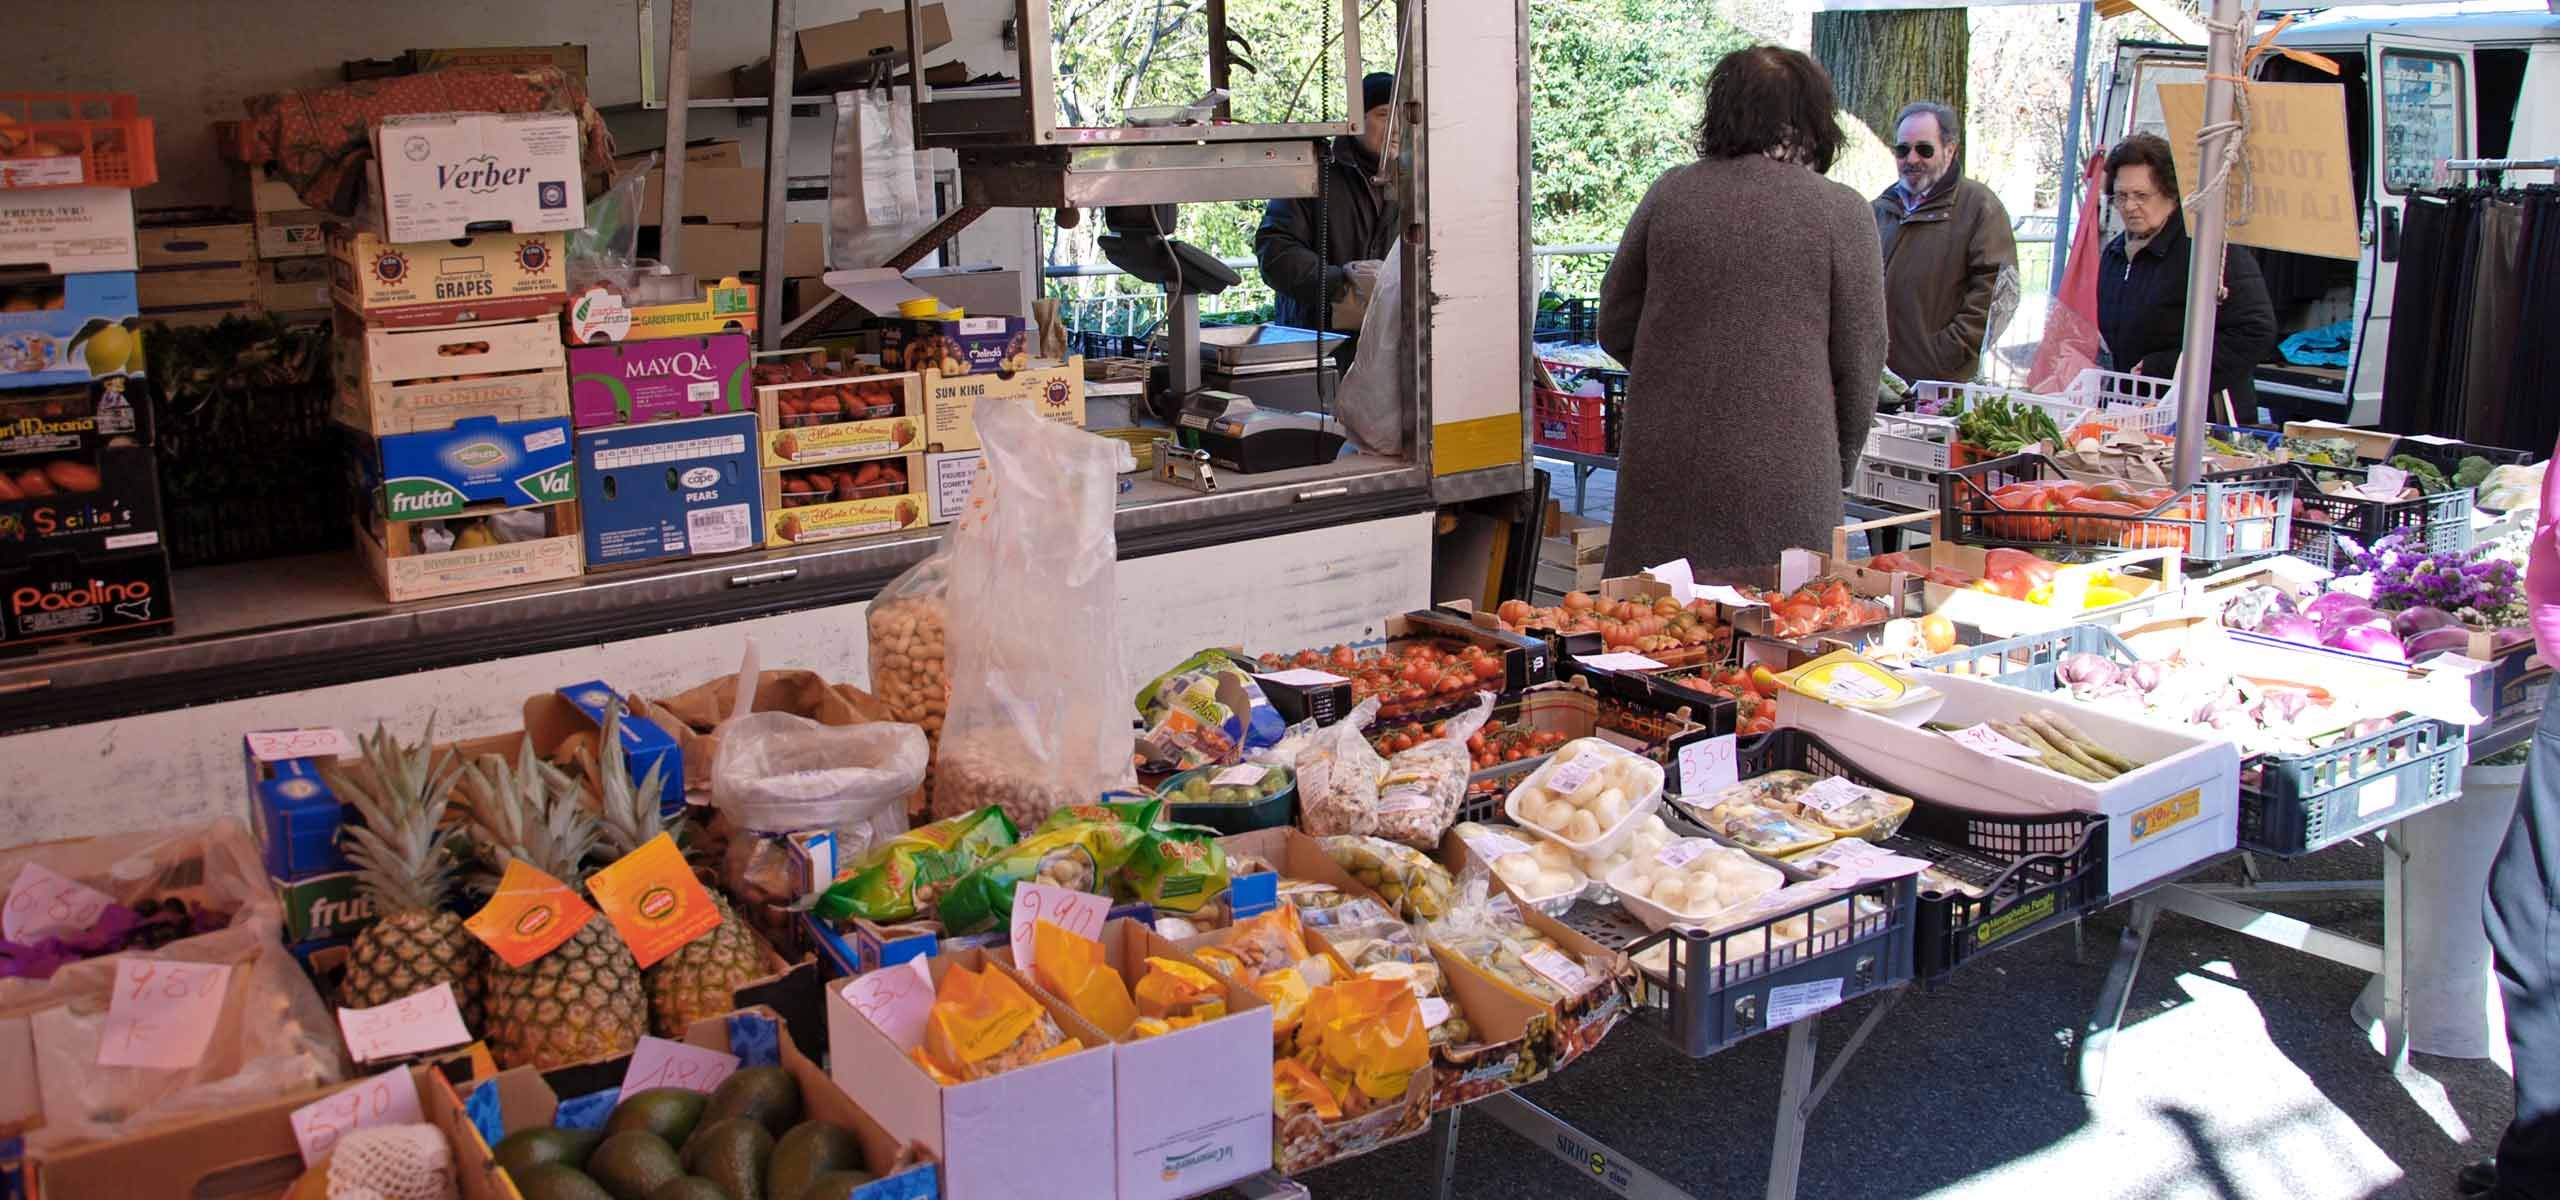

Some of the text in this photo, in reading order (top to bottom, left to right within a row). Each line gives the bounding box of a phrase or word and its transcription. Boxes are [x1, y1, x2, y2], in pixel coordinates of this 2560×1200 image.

[437, 162, 531, 191] Verber
[436, 279, 493, 300] GRAPES
[625, 351, 718, 381] MAYQA
[935, 384, 985, 400] SUN KING
[540, 472, 570, 496] Val
[392, 489, 454, 513] frutta
[685, 489, 719, 504] PEARS
[12, 577, 151, 617] Paolino
[1556, 1132, 1590, 1165] SIRIO
